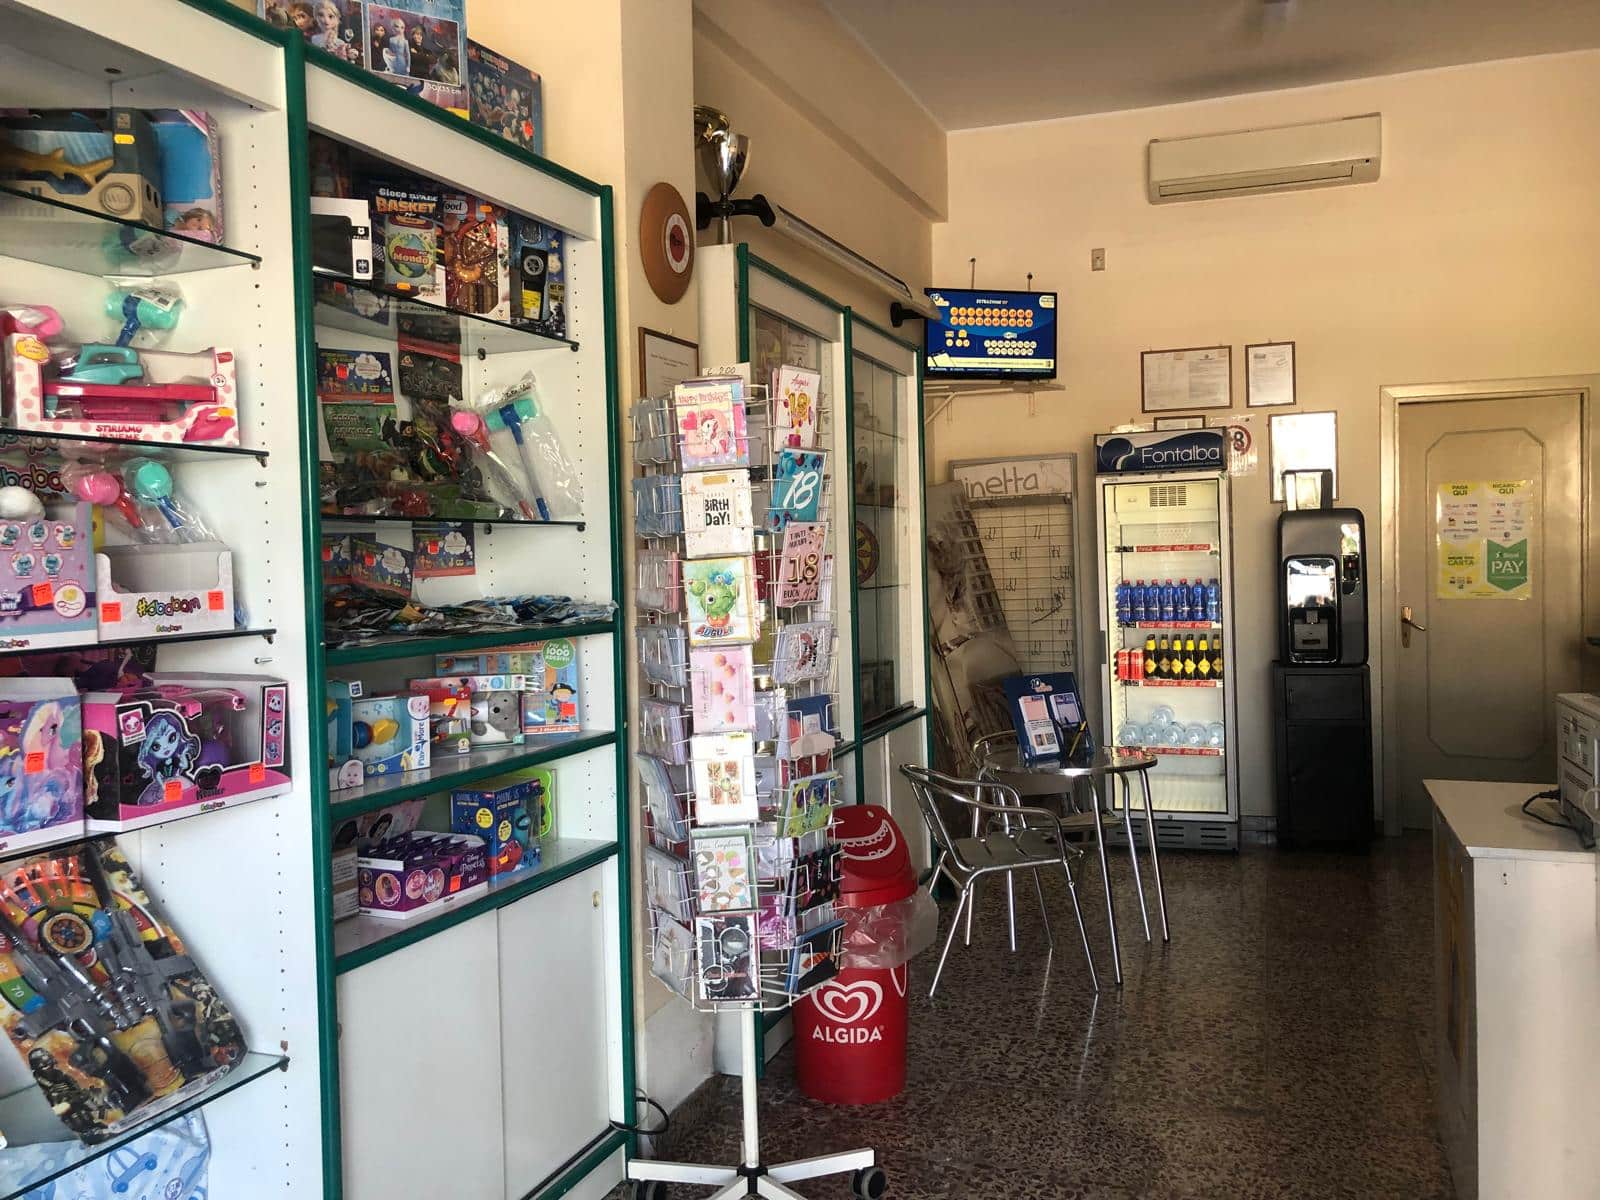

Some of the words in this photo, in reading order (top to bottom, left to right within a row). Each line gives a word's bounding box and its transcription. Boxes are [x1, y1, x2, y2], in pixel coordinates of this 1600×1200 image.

[378, 187, 407, 199] Gioco
[375, 196, 436, 214] BASKET
[96, 424, 142, 433] STIRIAMO
[1141, 444, 1220, 463] Fontalba
[783, 471, 818, 510] 18
[788, 552, 819, 585] 18
[1492, 560, 1524, 574] PAY
[546, 647, 570, 657] 1000
[11, 986, 24, 998] 70
[812, 1025, 883, 1045] ALGIDA
